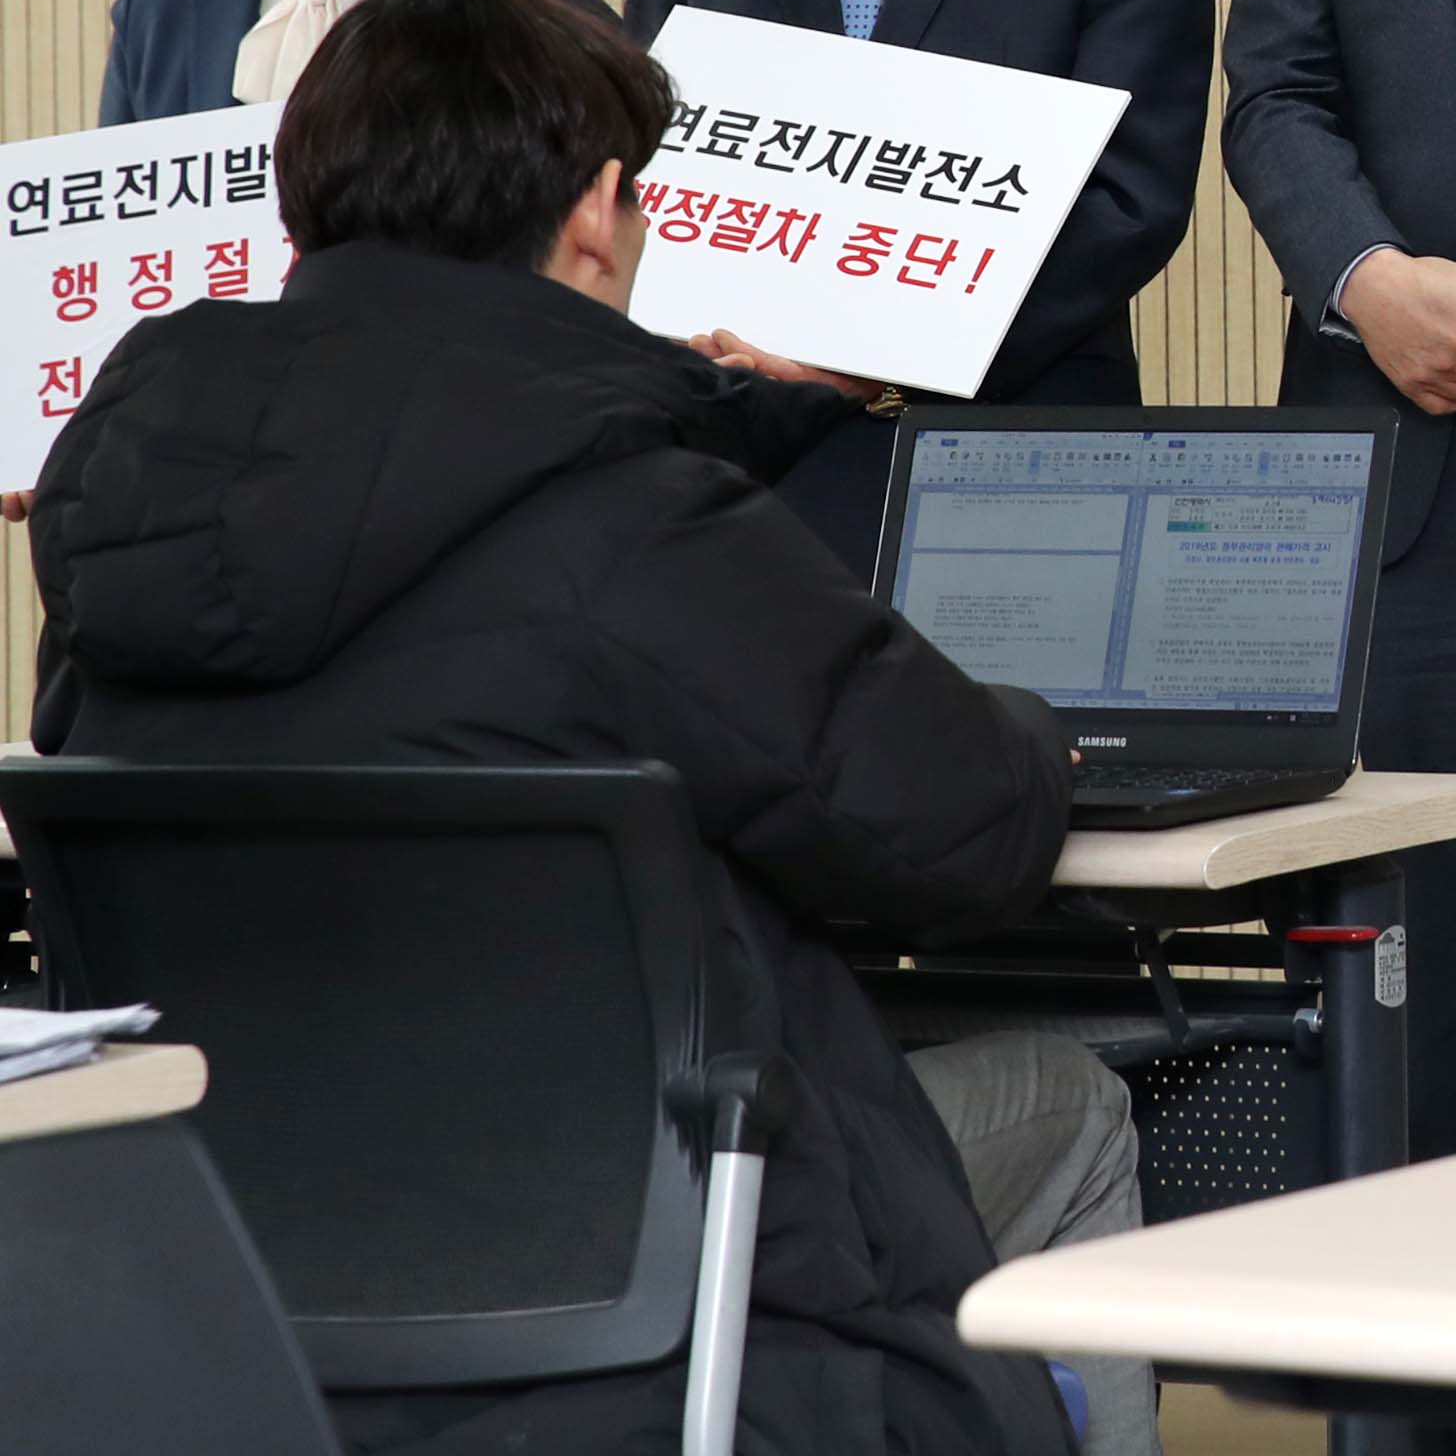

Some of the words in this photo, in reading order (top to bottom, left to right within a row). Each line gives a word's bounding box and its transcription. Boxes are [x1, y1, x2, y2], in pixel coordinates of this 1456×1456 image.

[6, 143, 273, 237] 연료전지발
[658, 99, 1029, 214] 연료전지발전소
[37, 355, 83, 419] 전
[1077, 735, 1128, 748] SAMSUNG
